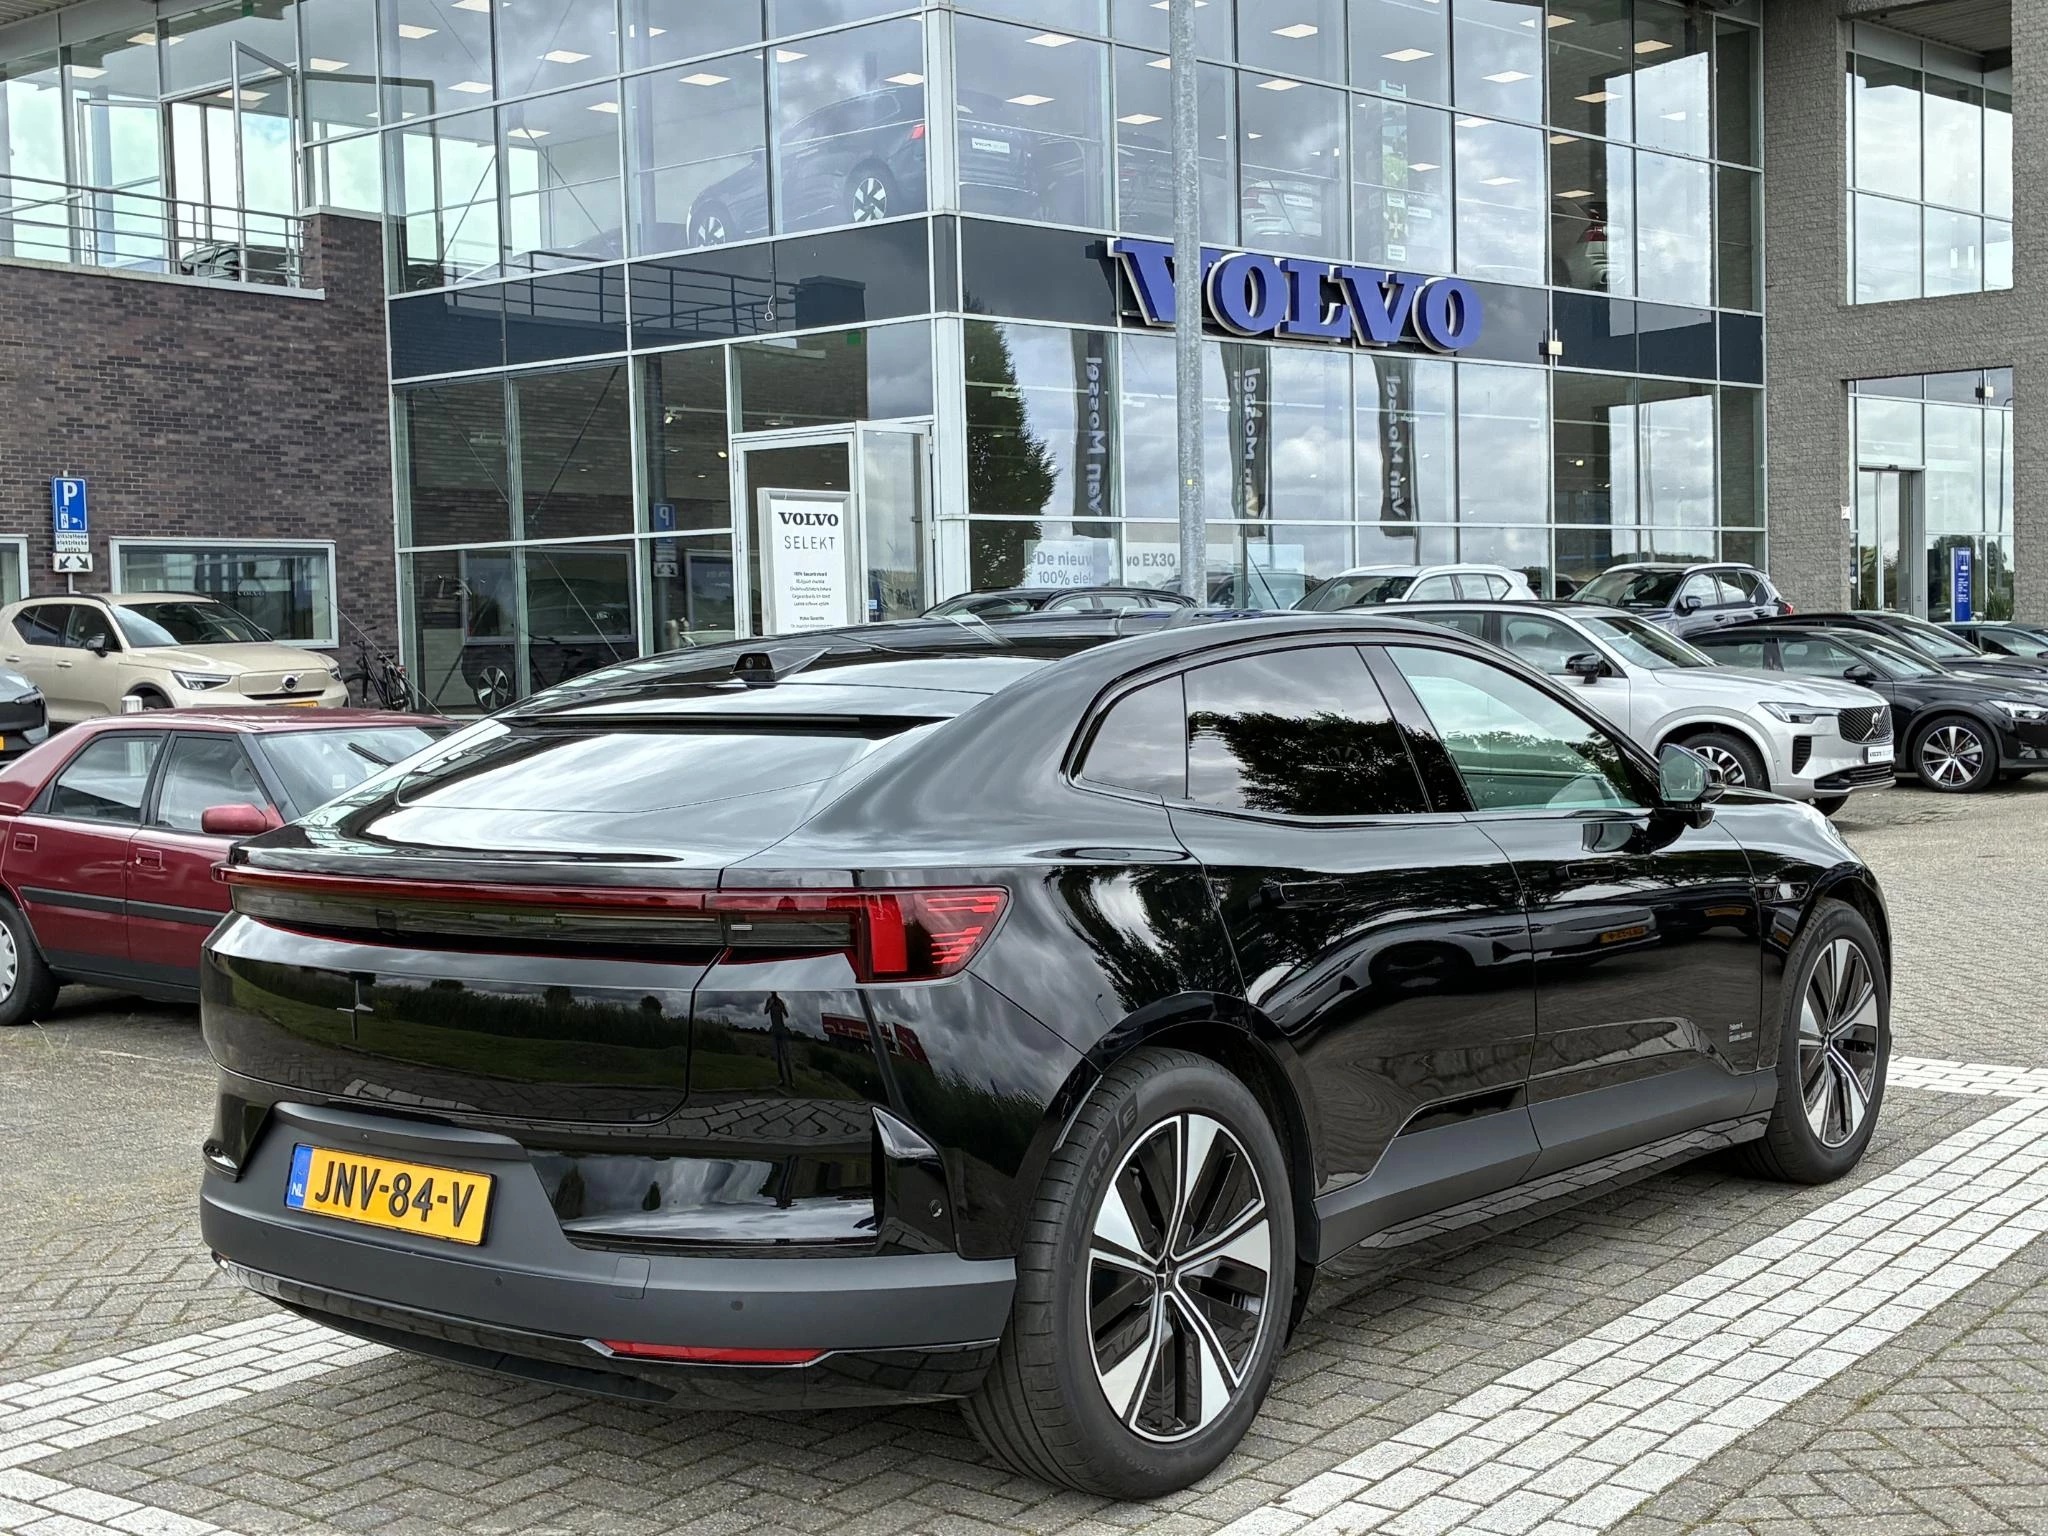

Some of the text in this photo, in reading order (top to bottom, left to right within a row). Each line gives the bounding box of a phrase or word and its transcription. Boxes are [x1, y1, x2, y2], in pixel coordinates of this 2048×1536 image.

[1107, 239, 1483, 353] VOLVO
[63, 481, 78, 506] P
[778, 512, 839, 527] VOLVO
[784, 535, 836, 551] SELEKT
[1037, 551, 1055, 566] De
[1142, 553, 1176, 567] EX30
[1038, 569, 1070, 586] 100%
[291, 1183, 304, 1197] NL
[315, 1160, 475, 1228] JNV-84-V
